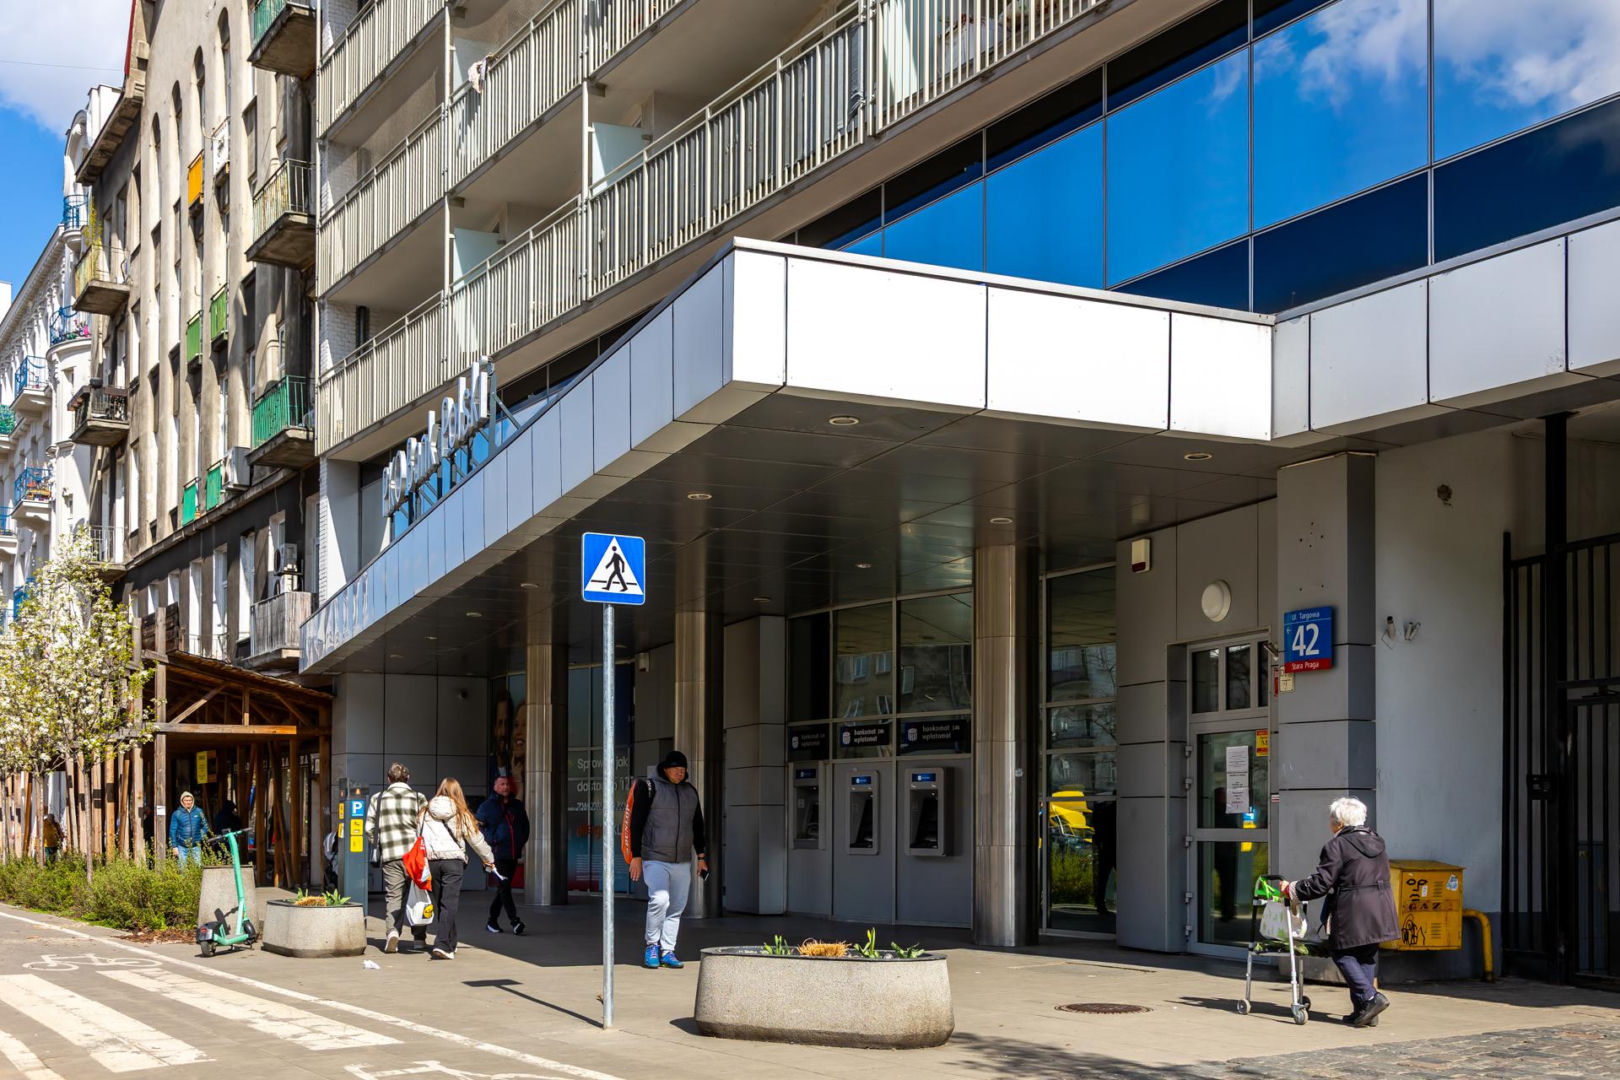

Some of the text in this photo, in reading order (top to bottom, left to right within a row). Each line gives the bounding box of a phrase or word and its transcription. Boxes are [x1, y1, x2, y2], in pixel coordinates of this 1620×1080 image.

[441, 354, 488, 458] Polski
[1299, 611, 1320, 621] Targowa
[1292, 623, 1320, 656] 42
[616, 756, 630, 771] jak
[353, 801, 363, 814] P
[1409, 902, 1441, 911] GAZ
